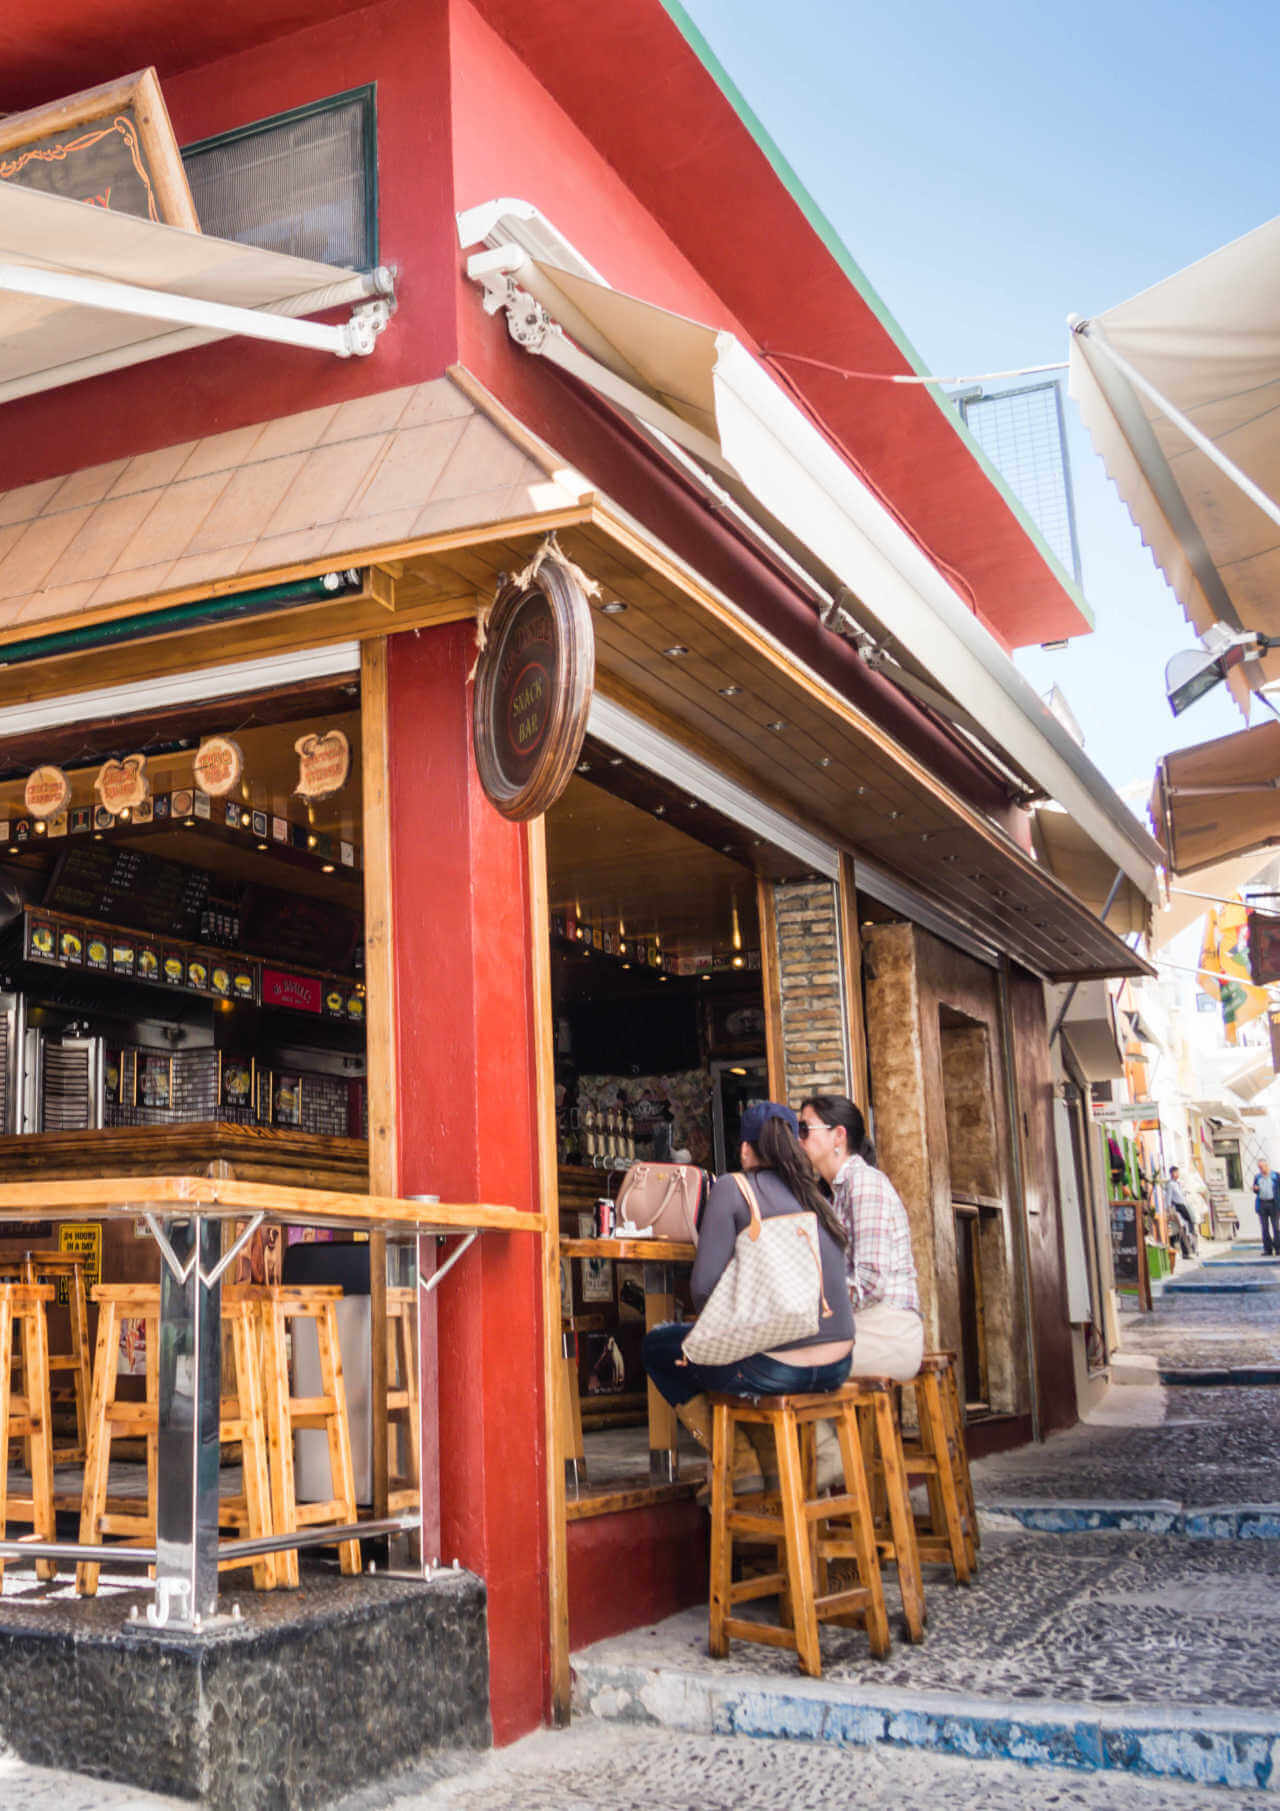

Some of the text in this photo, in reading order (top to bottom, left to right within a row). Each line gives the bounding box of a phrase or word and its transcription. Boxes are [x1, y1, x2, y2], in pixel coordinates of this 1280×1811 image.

[513, 678, 543, 718] SNACK
[519, 712, 539, 744] BAR
[63, 1231, 97, 1241] 24 HOURS
[66, 1241, 74, 1250] IN
[81, 1241, 94, 1250] DAY
